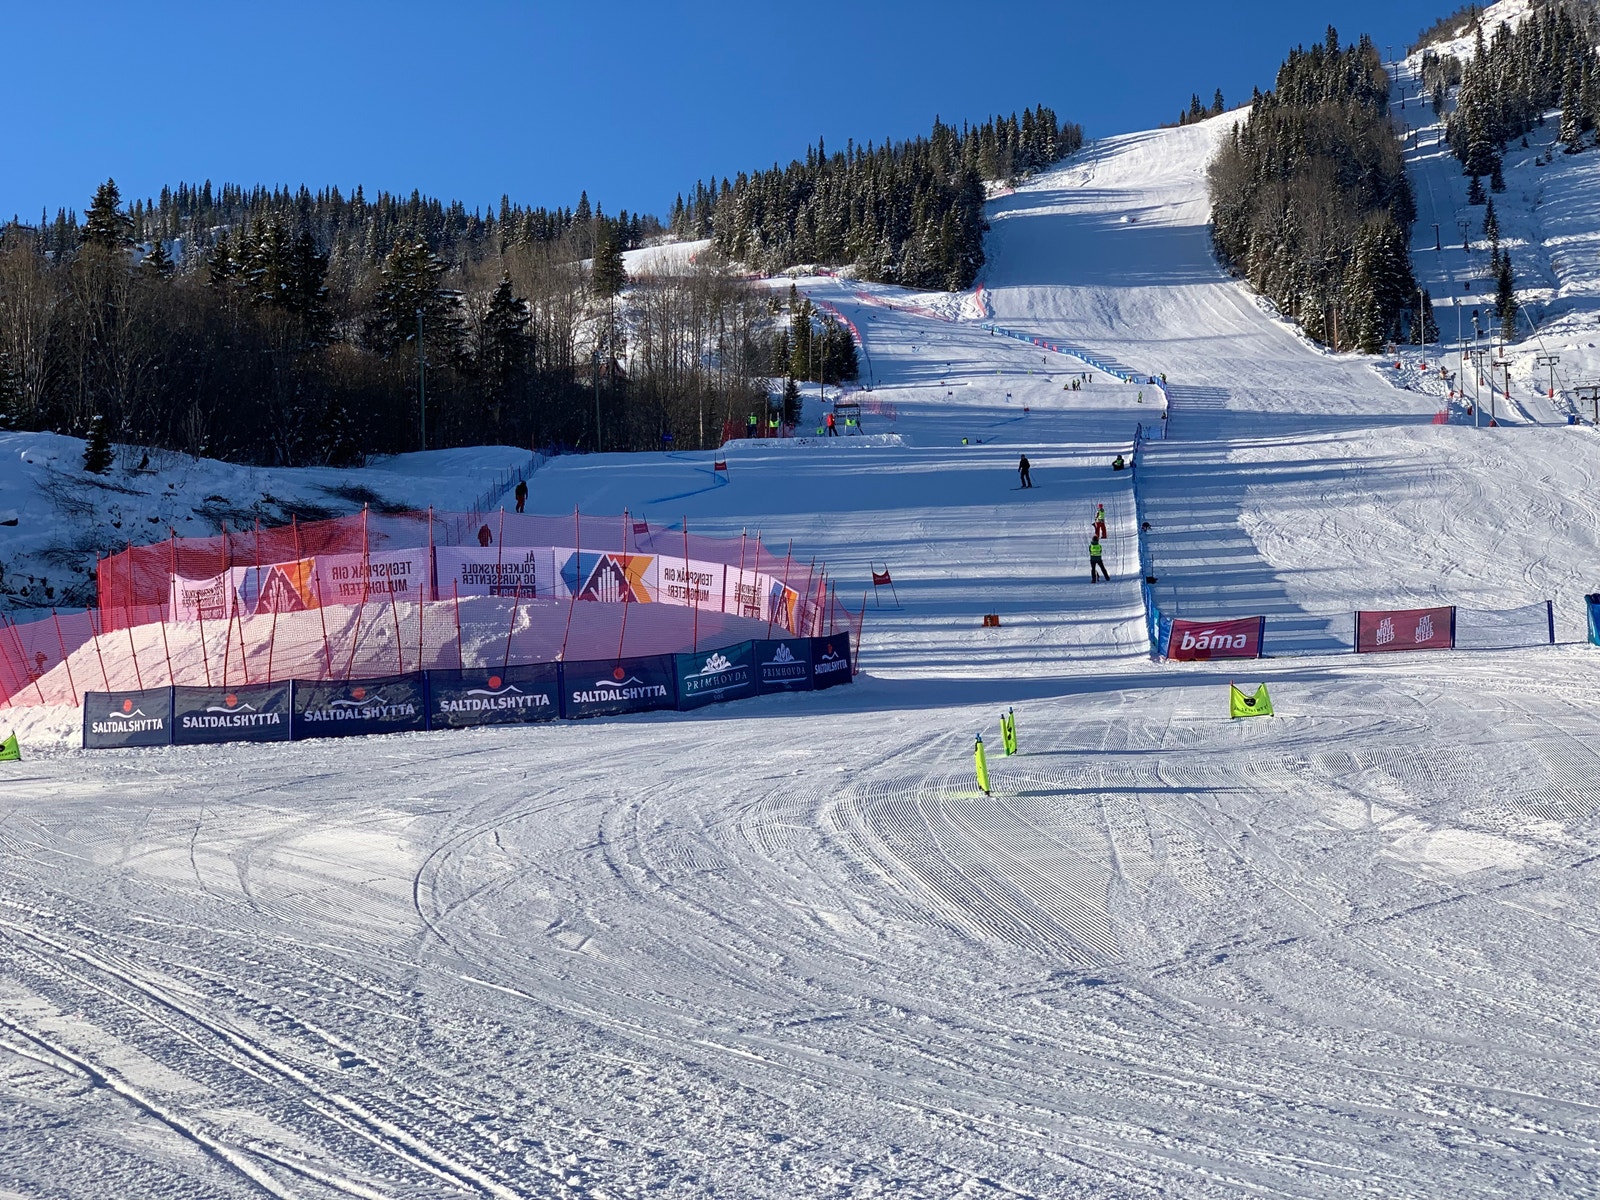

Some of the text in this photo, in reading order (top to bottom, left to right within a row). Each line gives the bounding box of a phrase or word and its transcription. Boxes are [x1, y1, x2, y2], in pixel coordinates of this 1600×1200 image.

[1380, 616, 1392, 628] EAT
[1419, 614, 1431, 626] EAT
[1376, 623, 1395, 637] MOVE
[1415, 621, 1433, 635] MOVE
[1376, 633, 1395, 646] SLEEP
[1415, 631, 1434, 644] SLEEP
[763, 666, 806, 677] PRIMHOVDA
[686, 671, 747, 691] PRIMHOVDA
[573, 684, 667, 703] SALTDALSHYTTA
[440, 694, 551, 712] SALTDALSHYTTA
[304, 703, 416, 722] SALTDALSHYTTA
[92, 718, 163, 733] SALTDALSHYTTA
[182, 712, 280, 728] SALTDALSHYTTA
